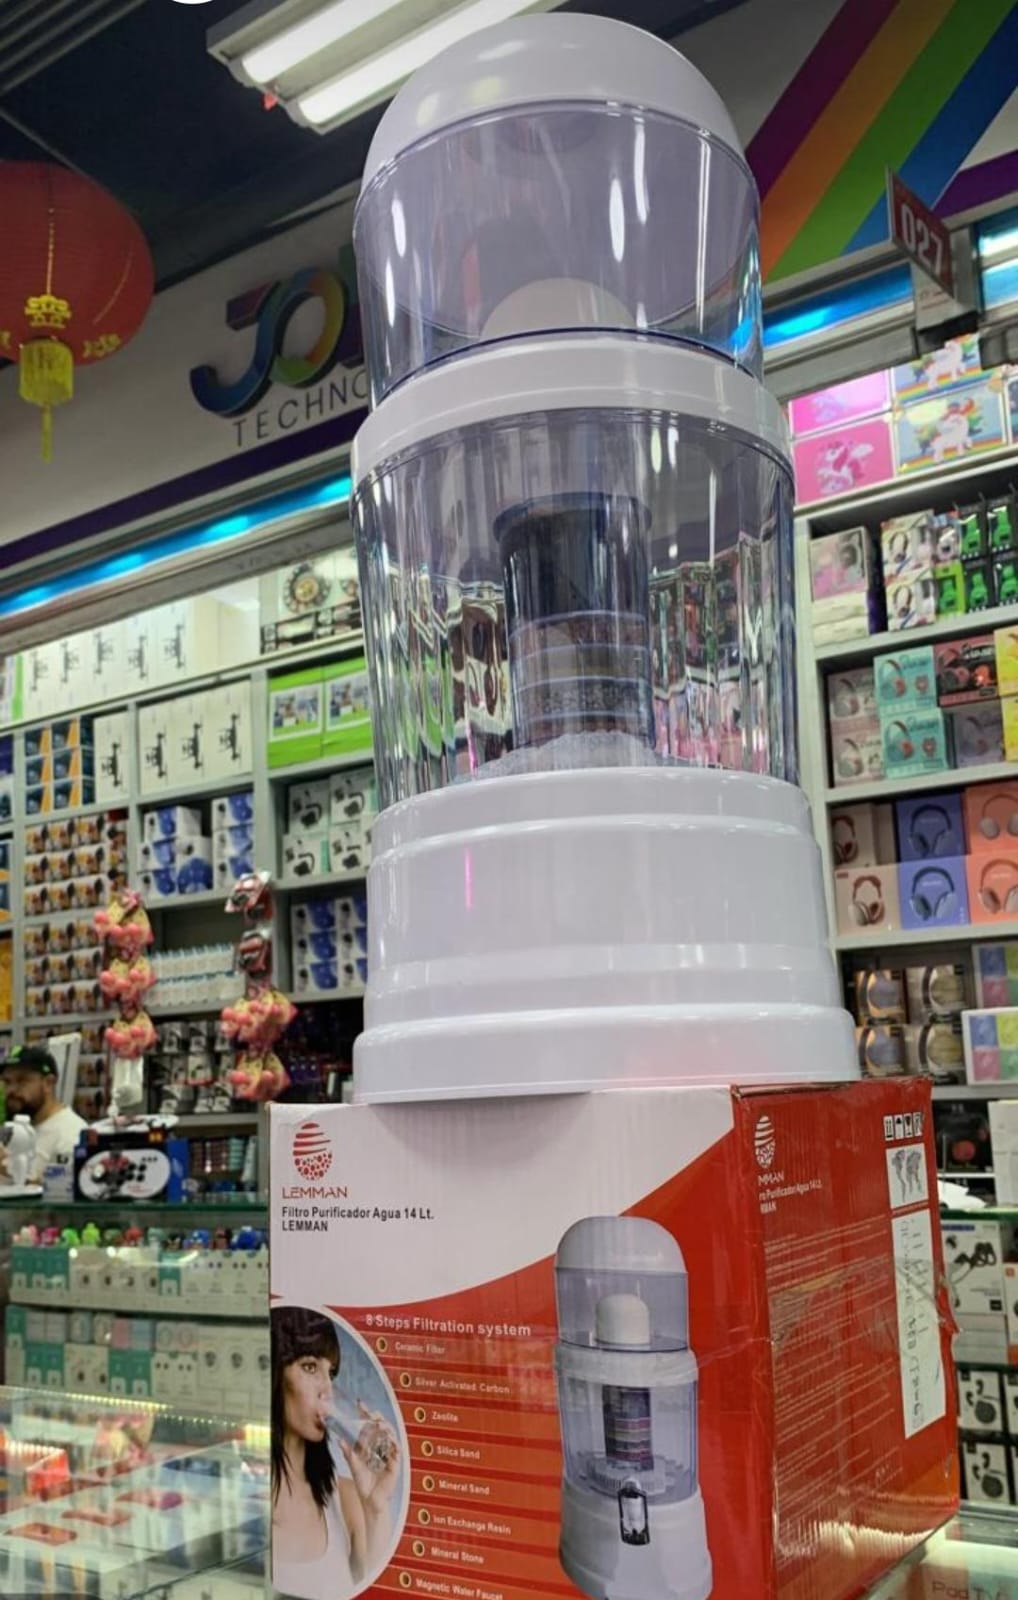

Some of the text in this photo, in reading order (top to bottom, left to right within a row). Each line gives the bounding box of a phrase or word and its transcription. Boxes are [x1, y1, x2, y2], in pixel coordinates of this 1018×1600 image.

[901, 203, 943, 278] 027
[282, 1186, 348, 1199] LEMMAN
[282, 1206, 434, 1221] Filtro Purificador Agua 14 Lt.
[282, 1220, 328, 1231] LEMMAN
[365, 1314, 531, 1338] 8 Steps Filtration system
[415, 1377, 511, 1393] Silver Activated Carbon
[432, 1411, 459, 1422] Zeolite
[437, 1445, 481, 1460] Silica Sand
[439, 1480, 490, 1496] Mineral Sand
[447, 1516, 486, 1533] Exchange
[487, 1522, 512, 1535] Resin
[431, 1547, 485, 1564] Mineral Stone
[416, 1579, 504, 1600] Magnetic Water Faucet
